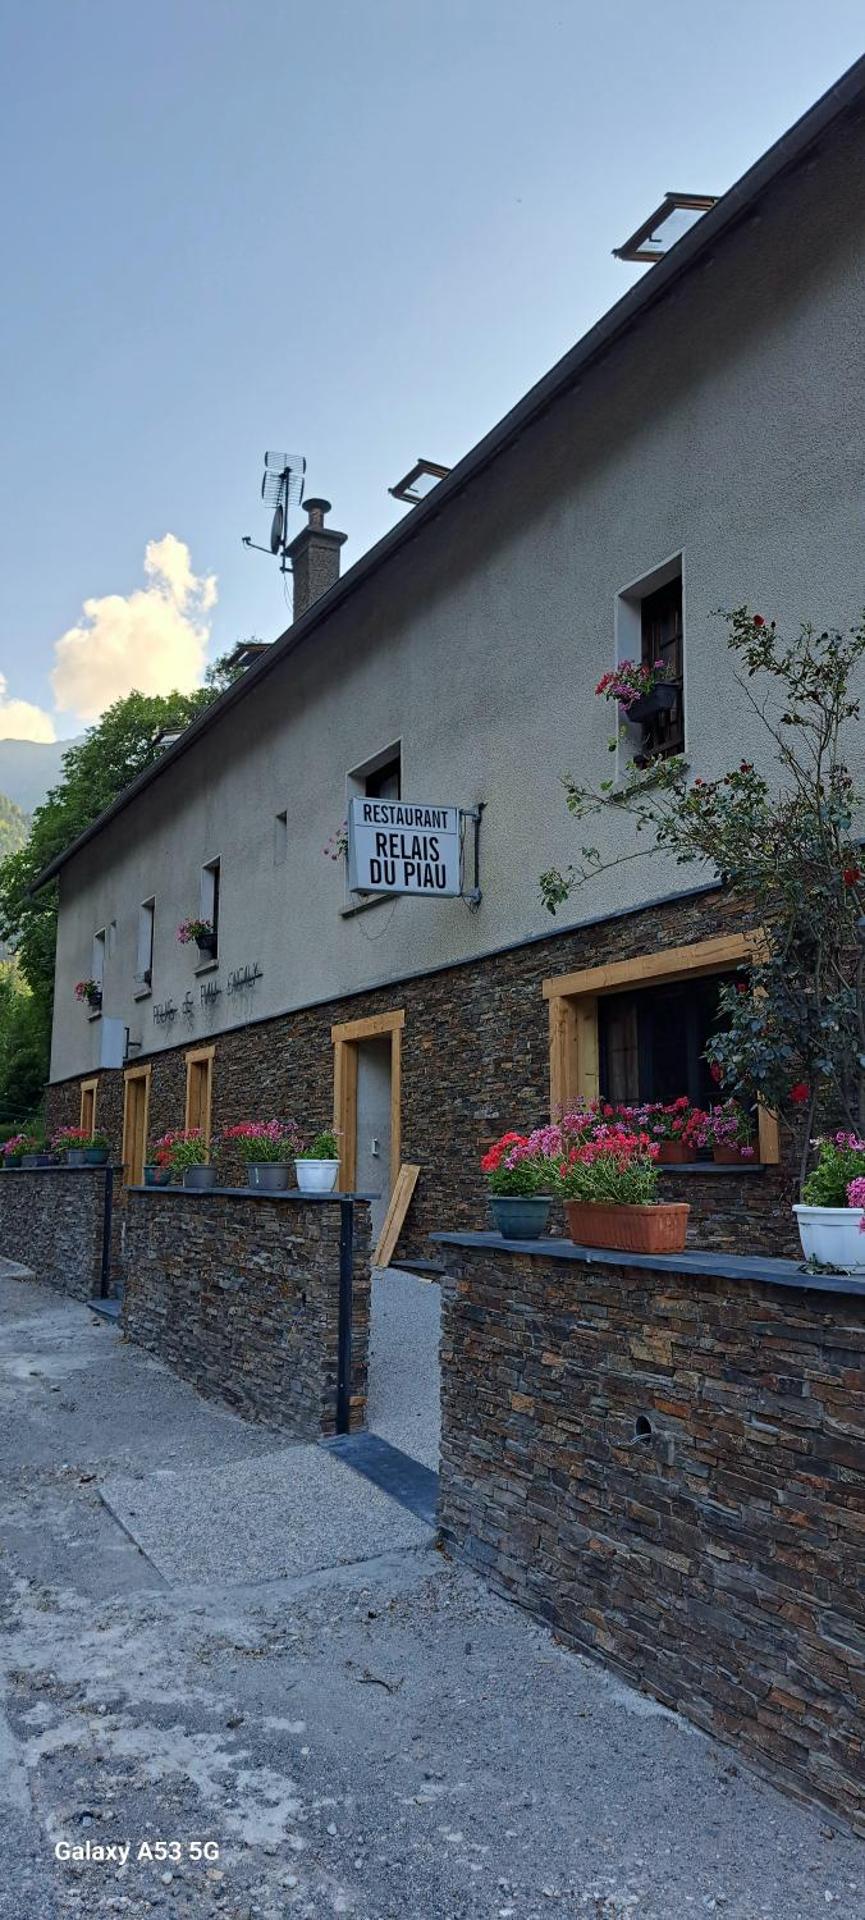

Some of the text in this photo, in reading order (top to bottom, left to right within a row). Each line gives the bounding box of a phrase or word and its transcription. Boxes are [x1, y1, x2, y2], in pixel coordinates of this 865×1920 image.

[363, 803, 449, 829] RESTAURANT
[375, 832, 440, 862] RELAIS
[370, 858, 446, 889] DU PIAU
